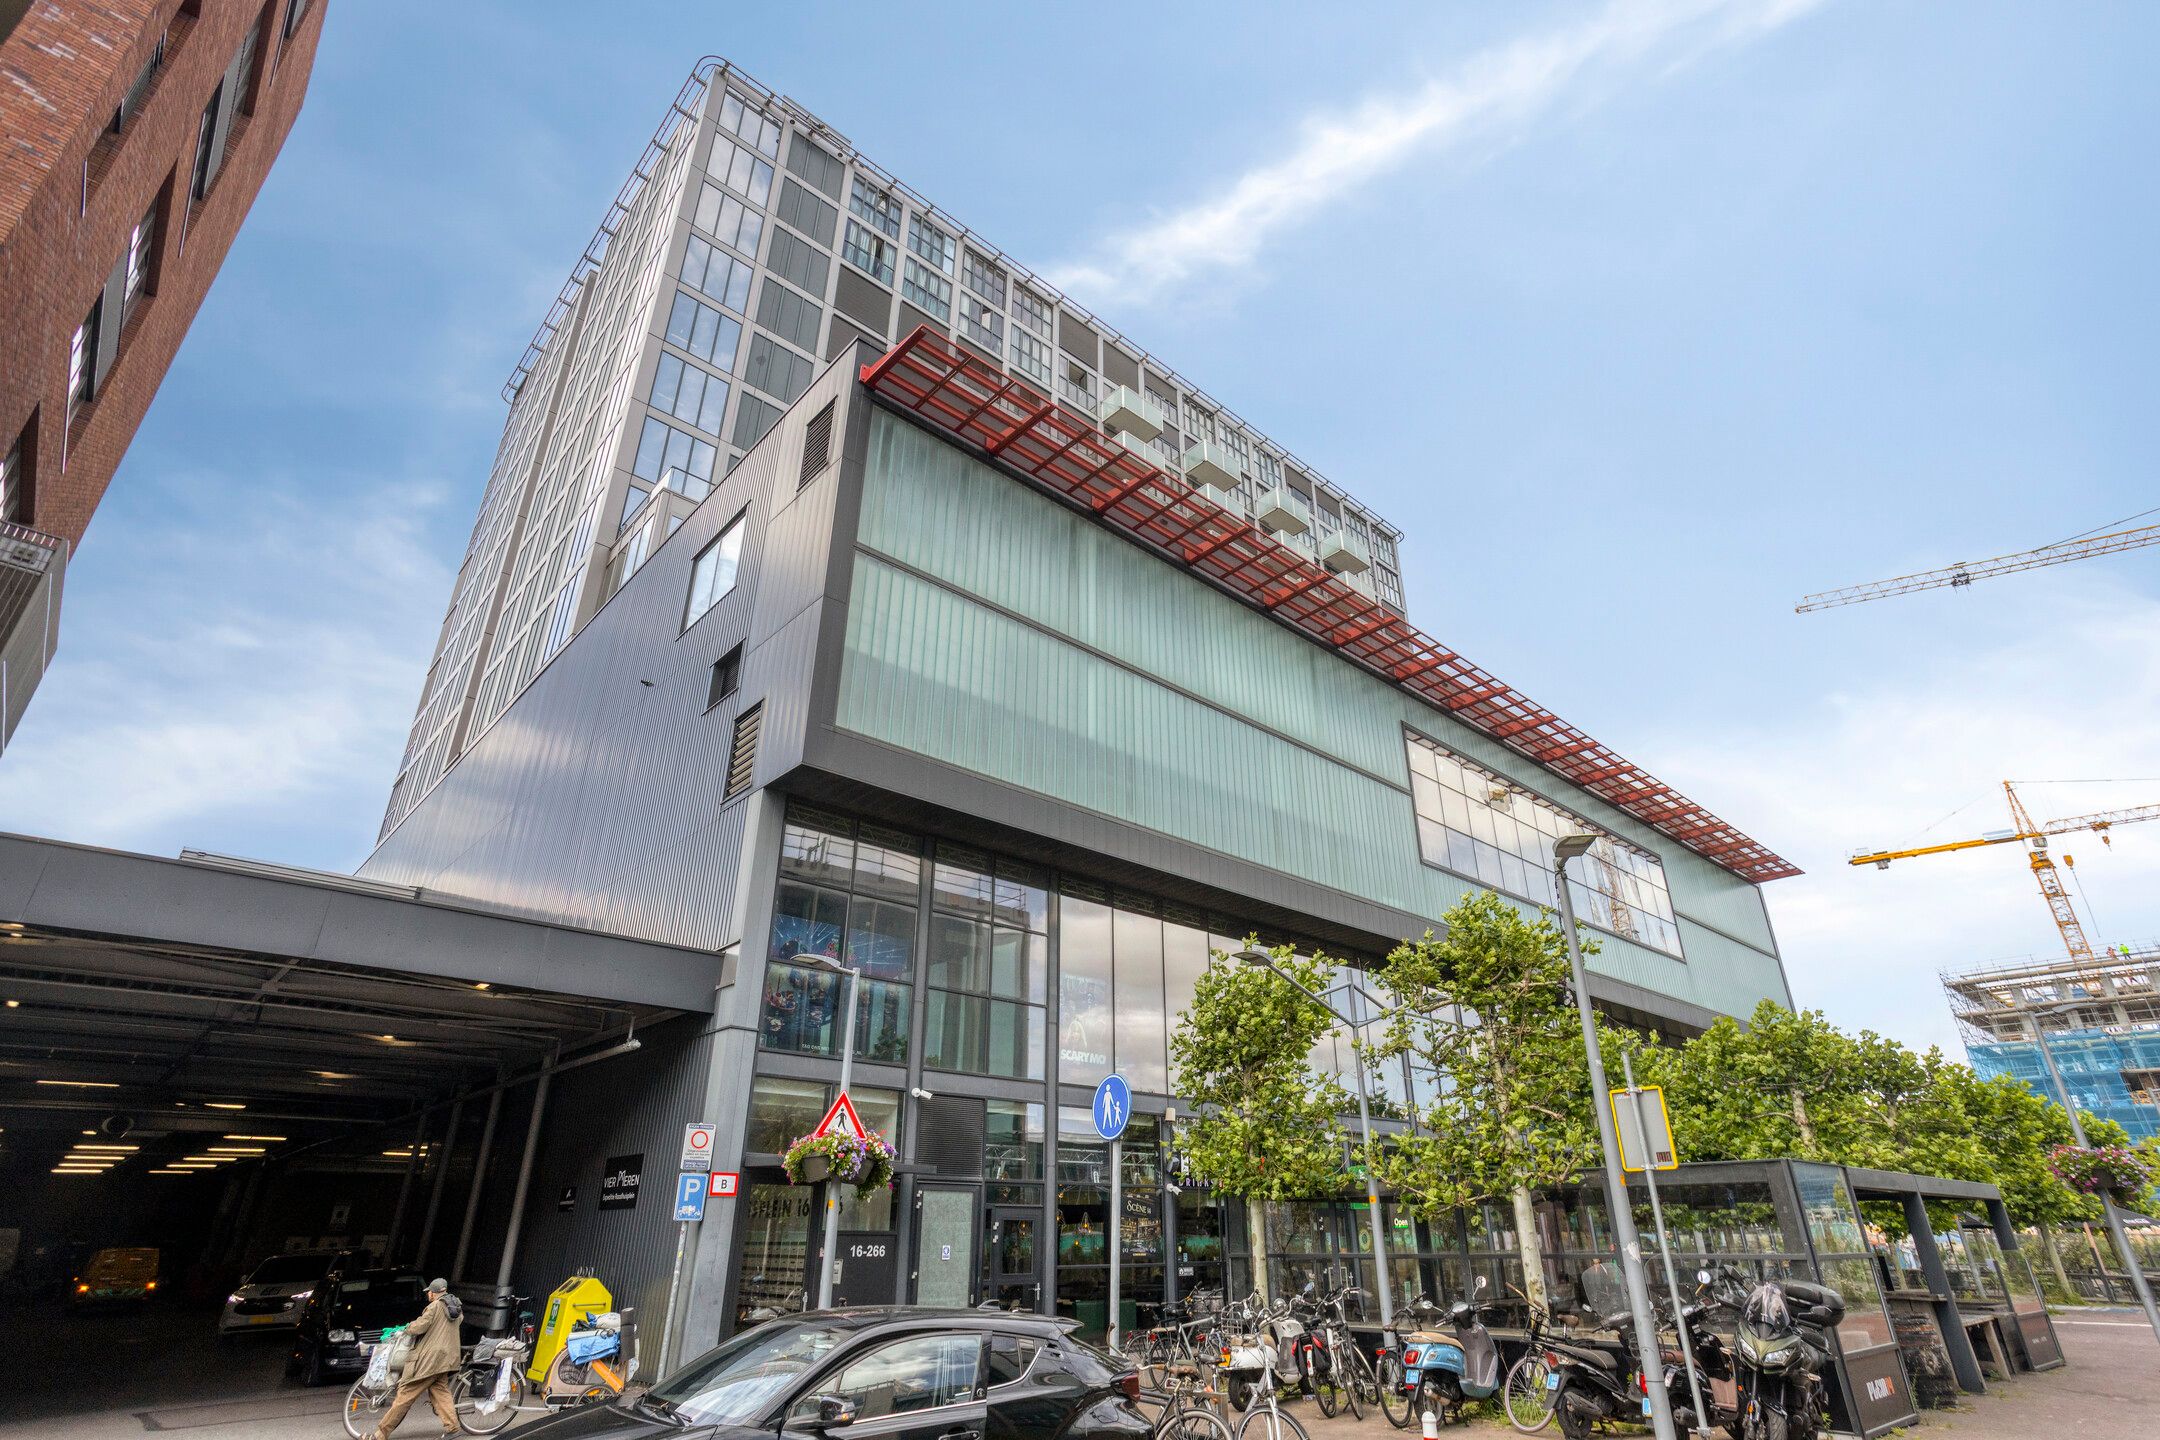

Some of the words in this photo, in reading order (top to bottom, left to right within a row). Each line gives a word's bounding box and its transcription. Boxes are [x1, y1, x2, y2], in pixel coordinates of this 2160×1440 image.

[1060, 1049, 1090, 1063] SCARY
[604, 1176, 617, 1188] VIER
[617, 1170, 640, 1187] MEREN
[721, 1179, 728, 1190] B
[684, 1178, 701, 1201] P
[1394, 1217, 1409, 1228] Open
[850, 1244, 886, 1258] 16-266
